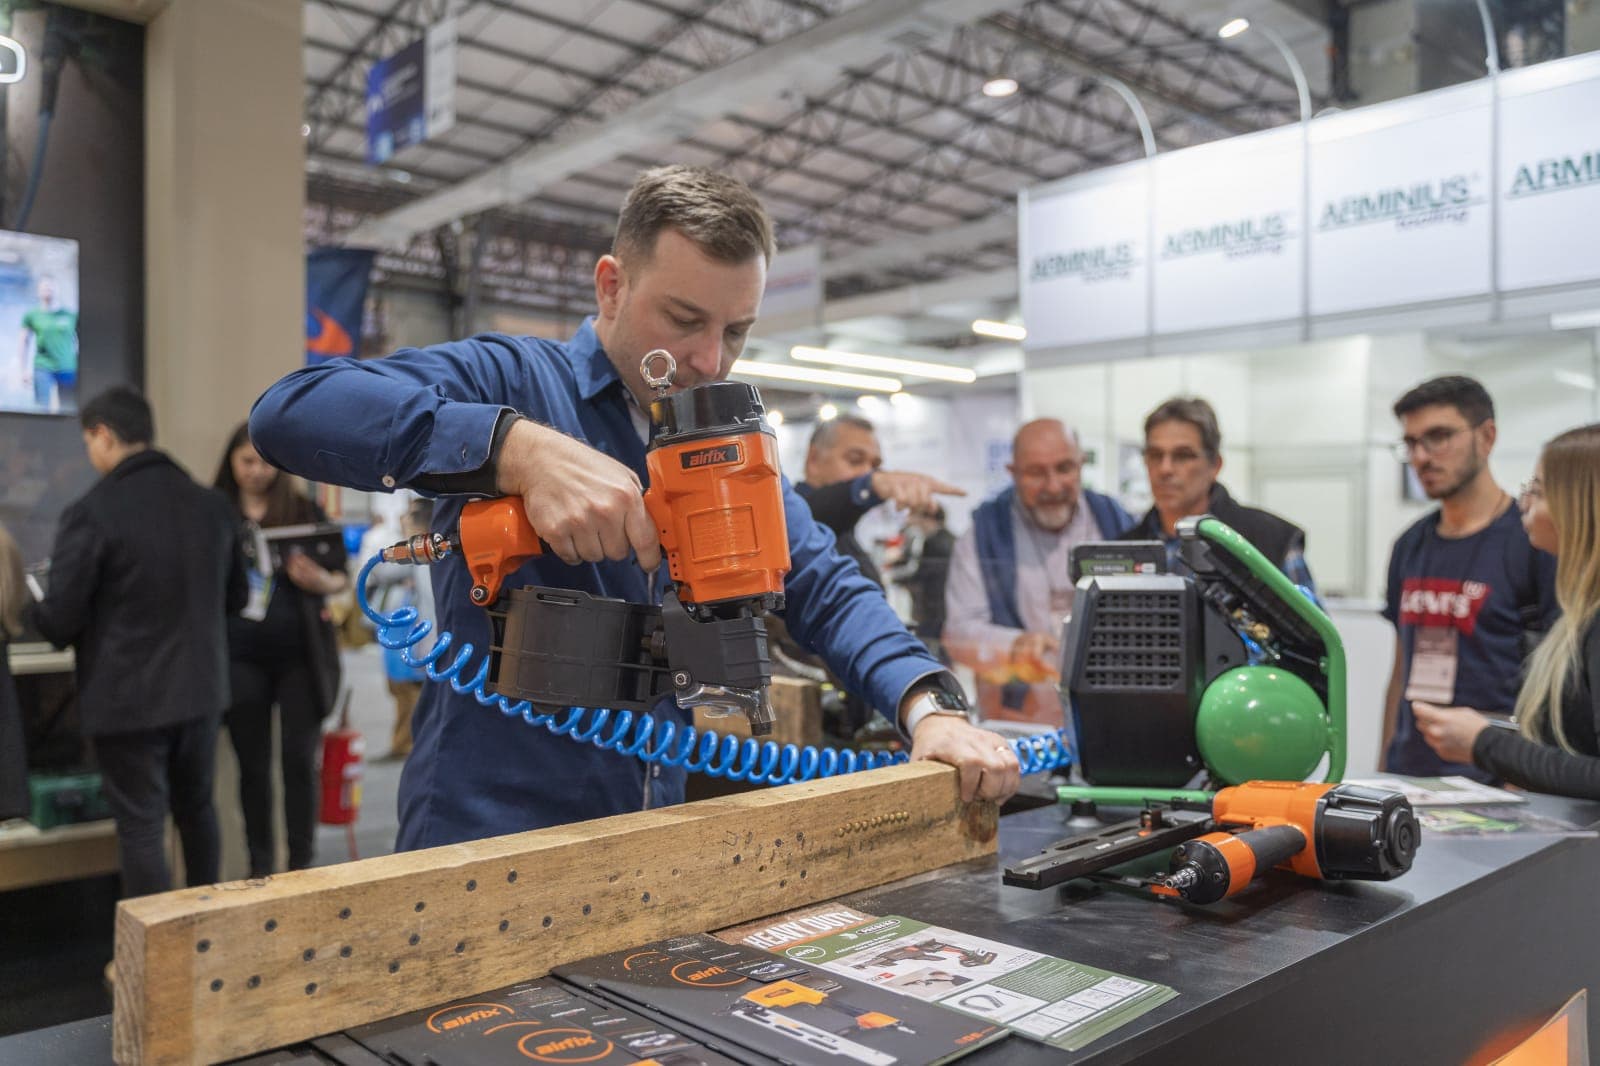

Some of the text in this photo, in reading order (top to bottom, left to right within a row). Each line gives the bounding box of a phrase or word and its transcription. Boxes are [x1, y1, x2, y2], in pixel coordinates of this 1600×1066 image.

[1319, 174, 1469, 230] ARMINIUS
[690, 449, 727, 467] airfix
[743, 921, 817, 950] HEAVY
[799, 911, 864, 931] DUTY
[442, 1007, 501, 1030] airfix
[535, 1036, 597, 1055] airfix
